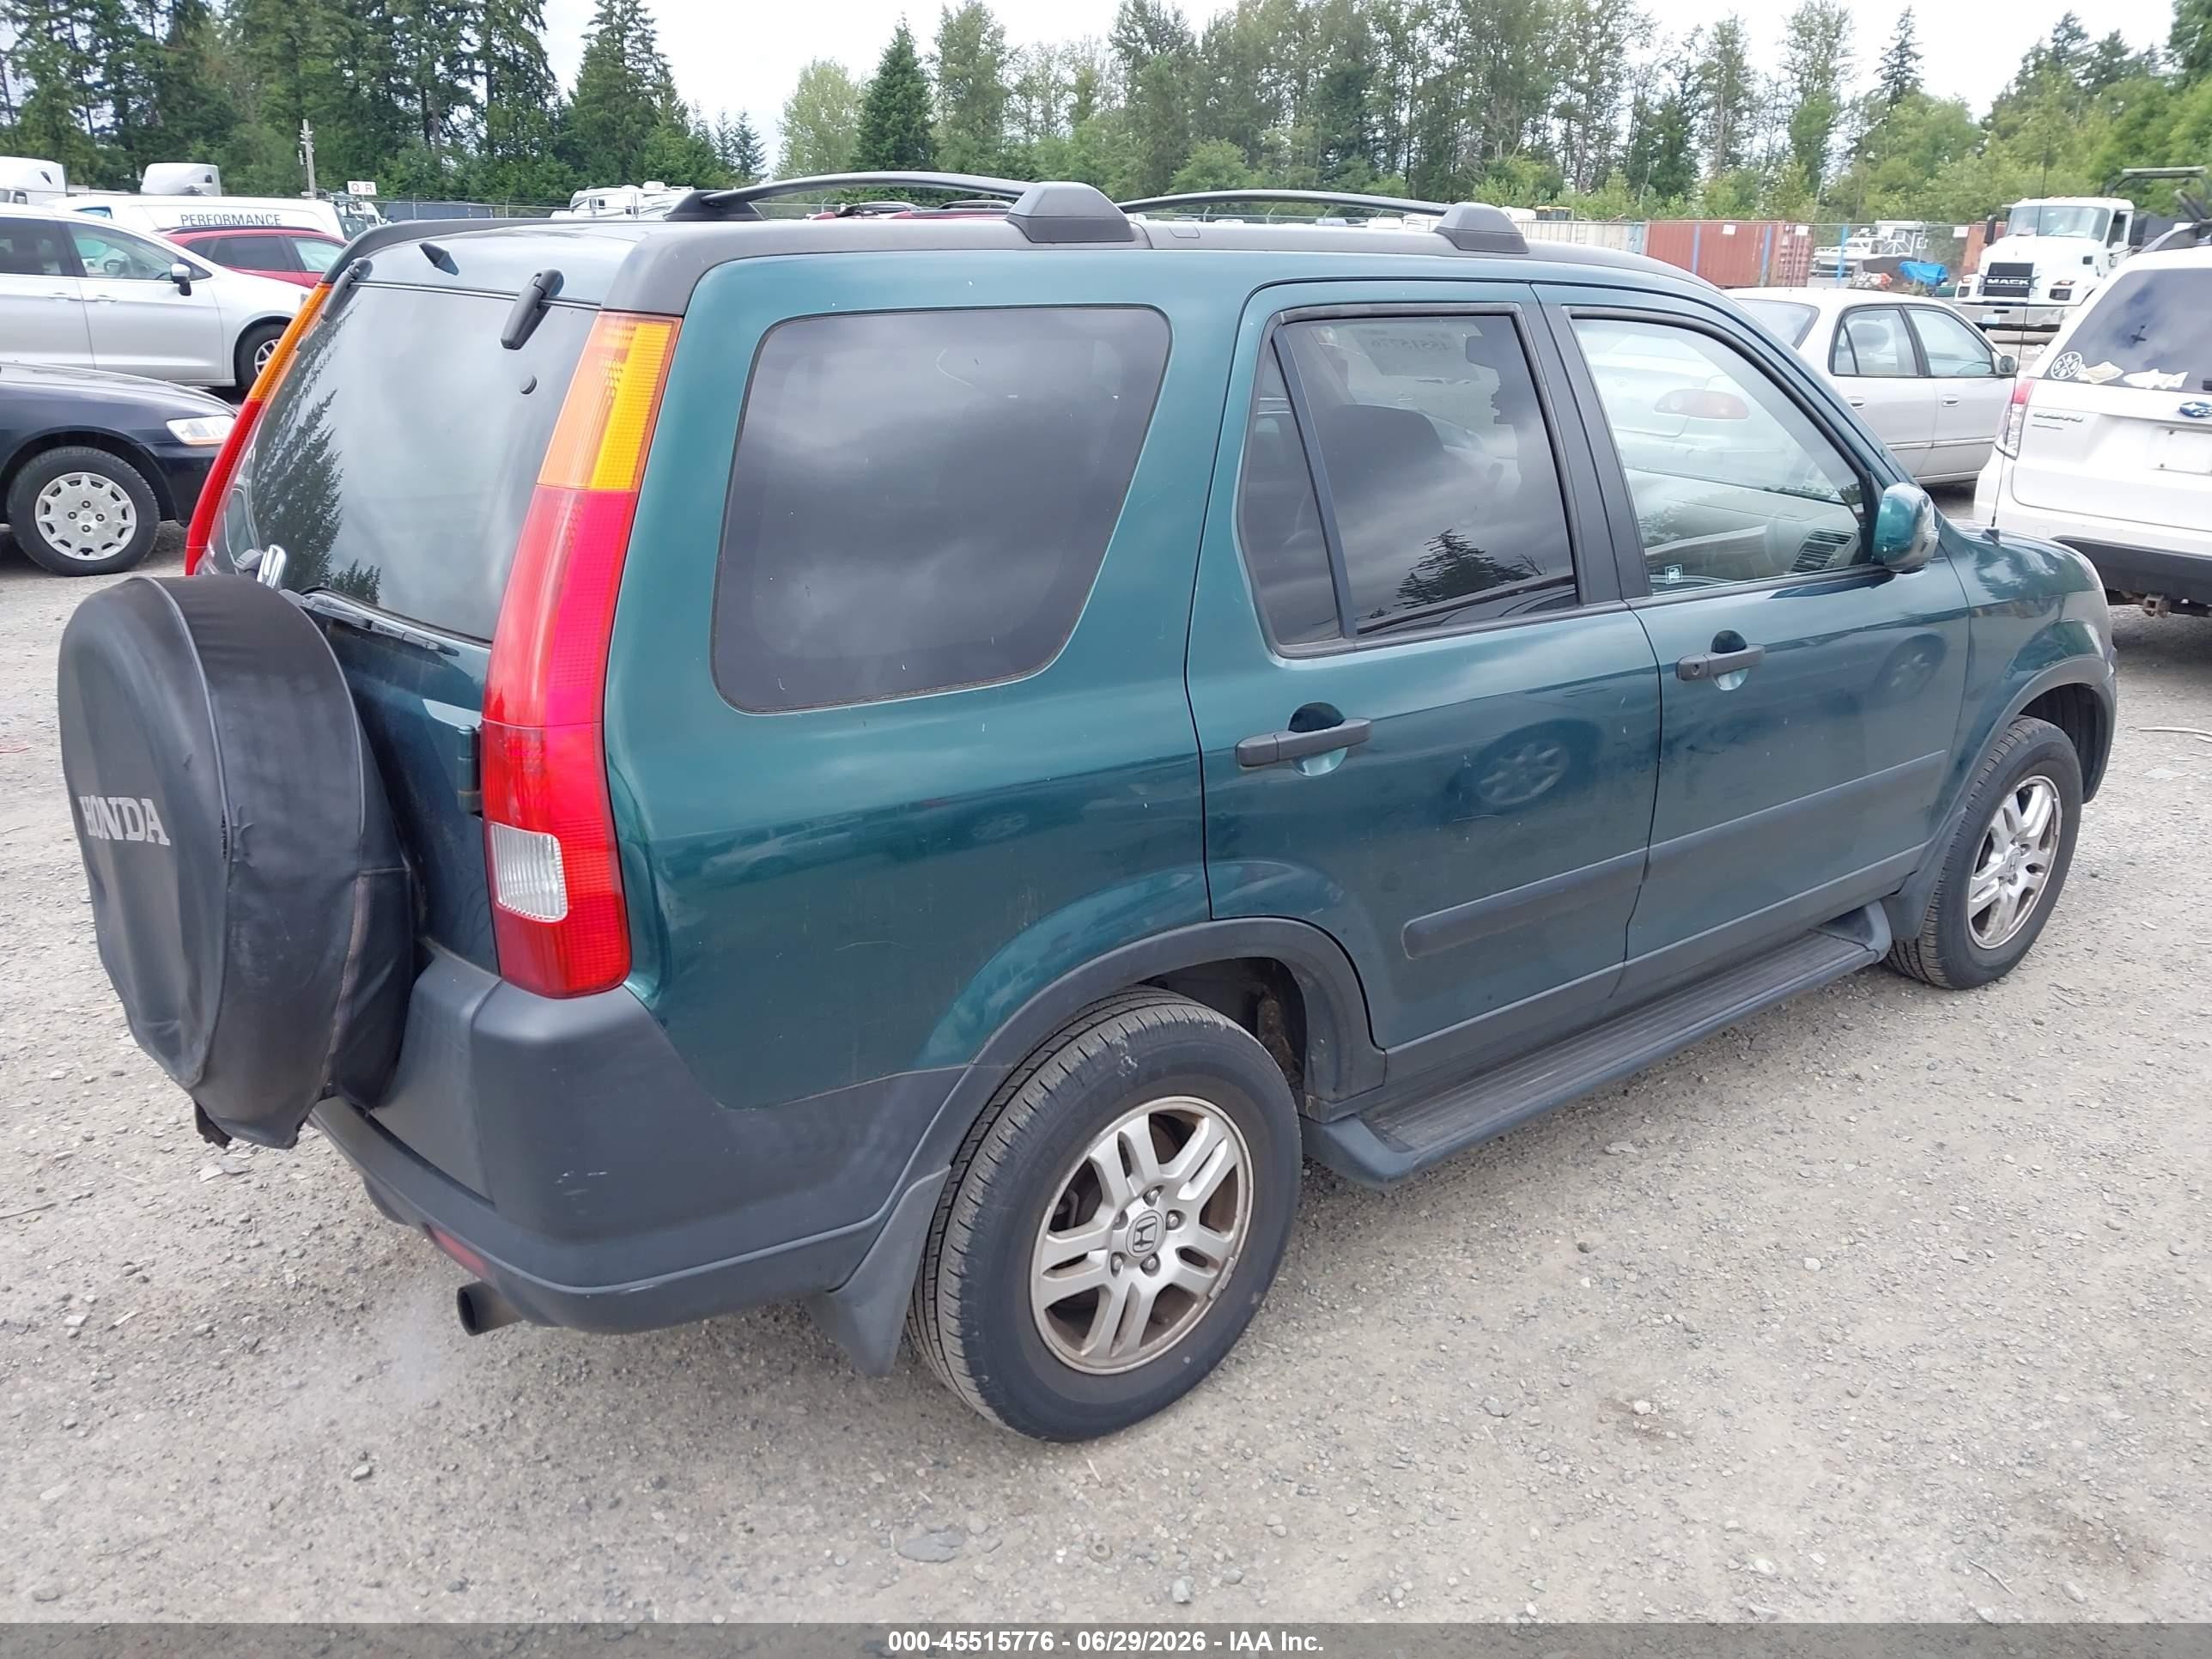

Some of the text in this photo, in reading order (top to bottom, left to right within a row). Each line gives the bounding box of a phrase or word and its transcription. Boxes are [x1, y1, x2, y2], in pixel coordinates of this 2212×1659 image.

[351, 183, 373, 192] Q R
[180, 214, 283, 226] PERFORMANCE
[79, 795, 171, 846] HONDA
